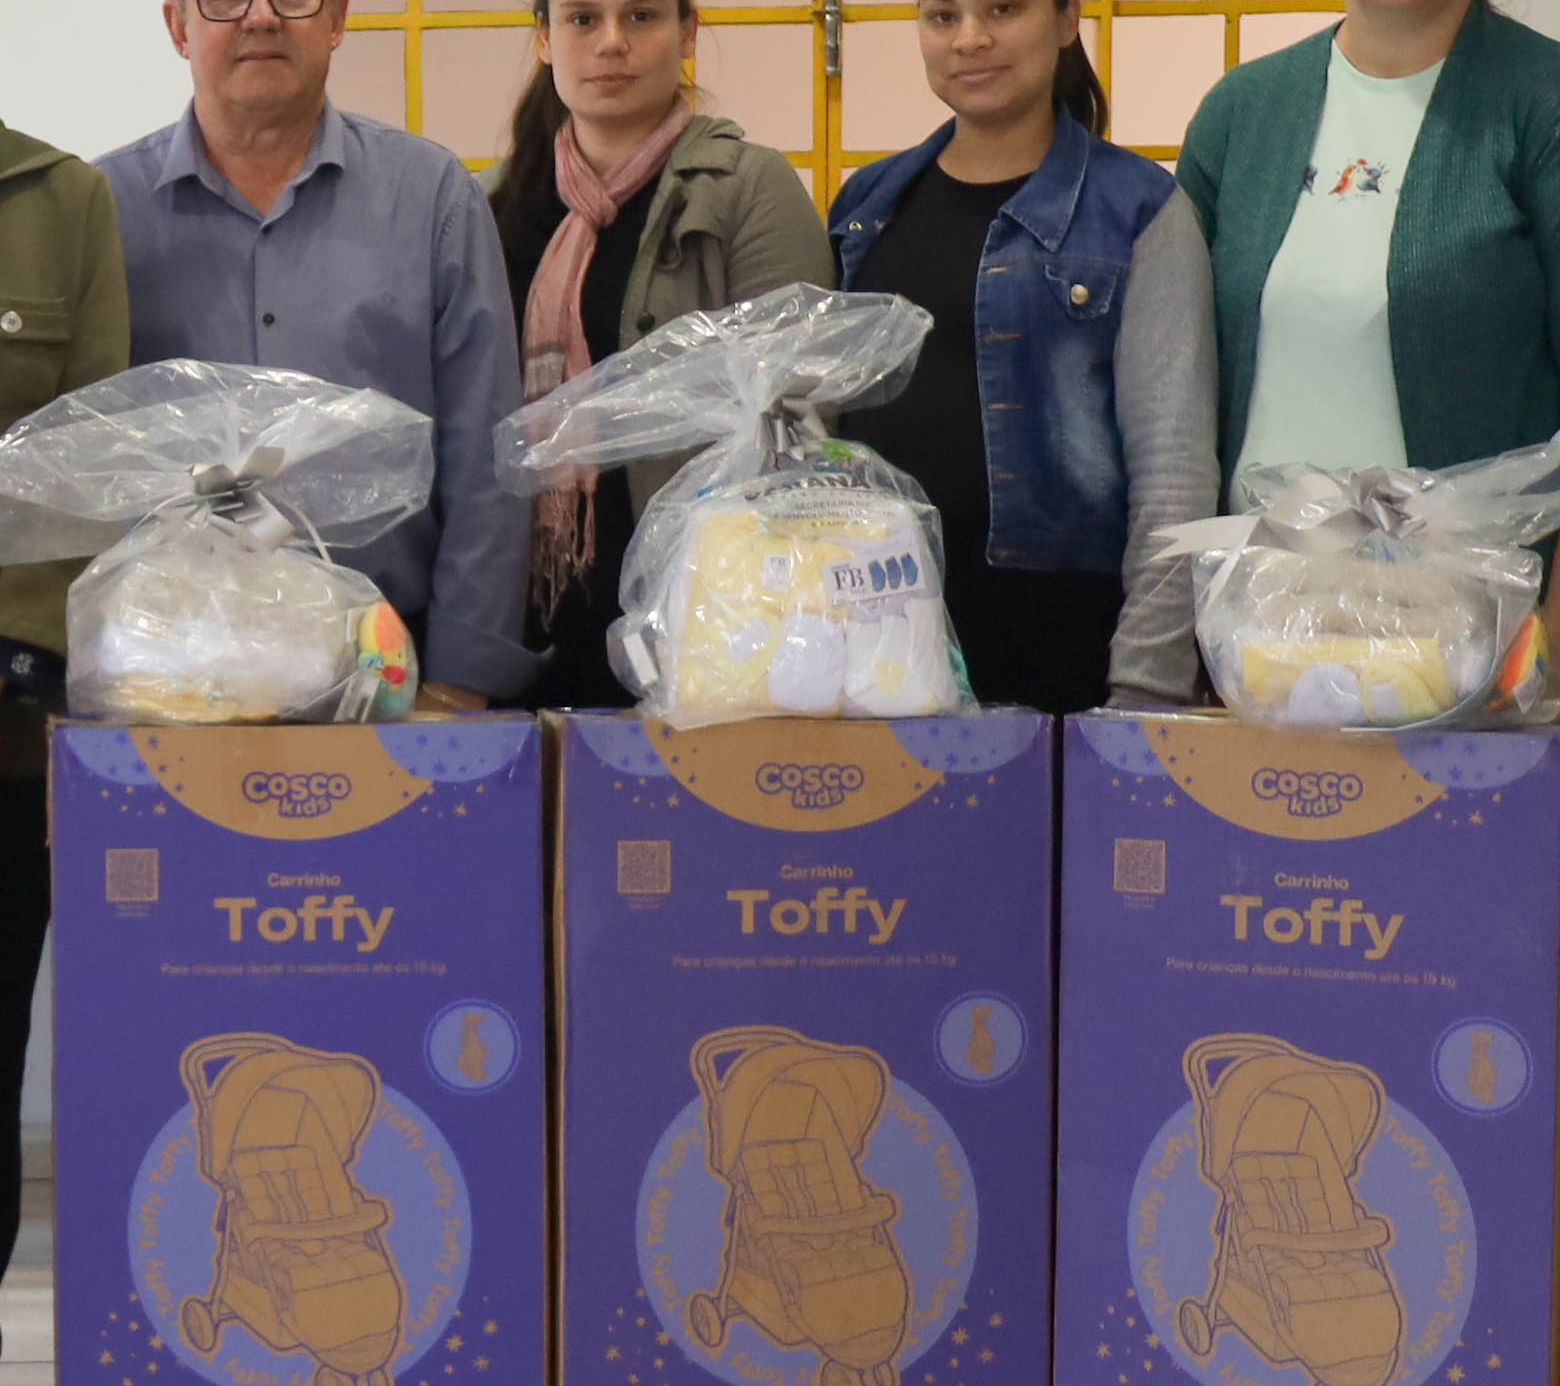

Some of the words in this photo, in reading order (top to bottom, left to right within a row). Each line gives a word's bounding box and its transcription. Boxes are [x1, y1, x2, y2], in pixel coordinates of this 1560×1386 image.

[834, 567, 865, 590] FB
[792, 786, 844, 809] kids
[1288, 794, 1341, 817] kids
[267, 873, 341, 887] Carrinho
[780, 864, 853, 880] Carrinho
[1274, 872, 1349, 891] Carrinho
[214, 895, 394, 952] Toffy
[726, 886, 907, 944] Toffy
[1220, 894, 1405, 960] Toffy
[1166, 957, 1192, 971] Para
[1196, 959, 1249, 976] crianças
[1252, 962, 1289, 976] desde
[1304, 966, 1377, 982] nascimento
